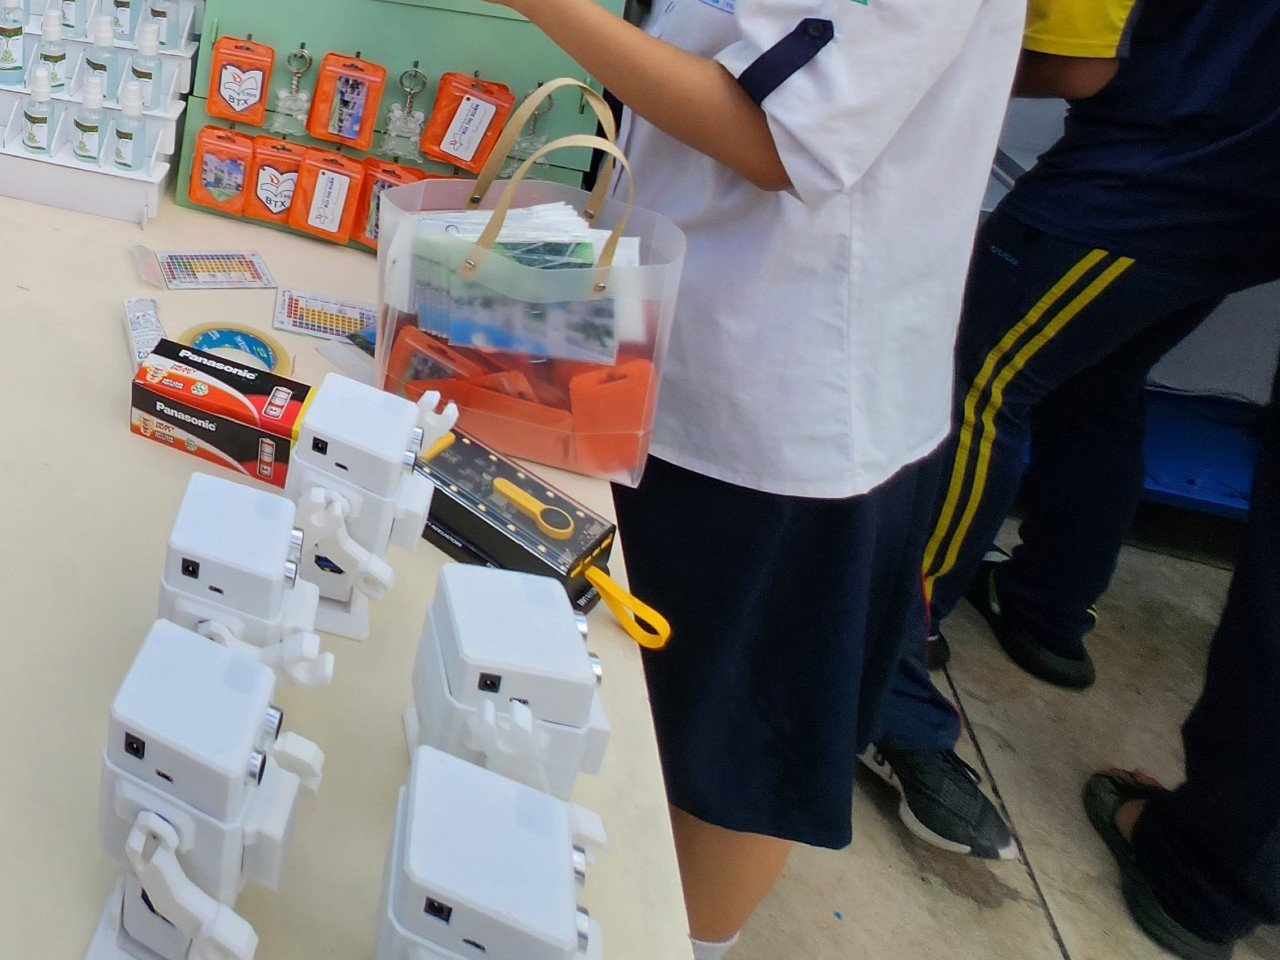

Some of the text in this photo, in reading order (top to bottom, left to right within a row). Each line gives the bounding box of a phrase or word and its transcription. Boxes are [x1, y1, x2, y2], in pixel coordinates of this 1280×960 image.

[228, 94, 249, 106] BTX
[265, 196, 287, 208] BTX
[179, 349, 257, 380] Panasonic
[155, 401, 217, 431] Panasonic
